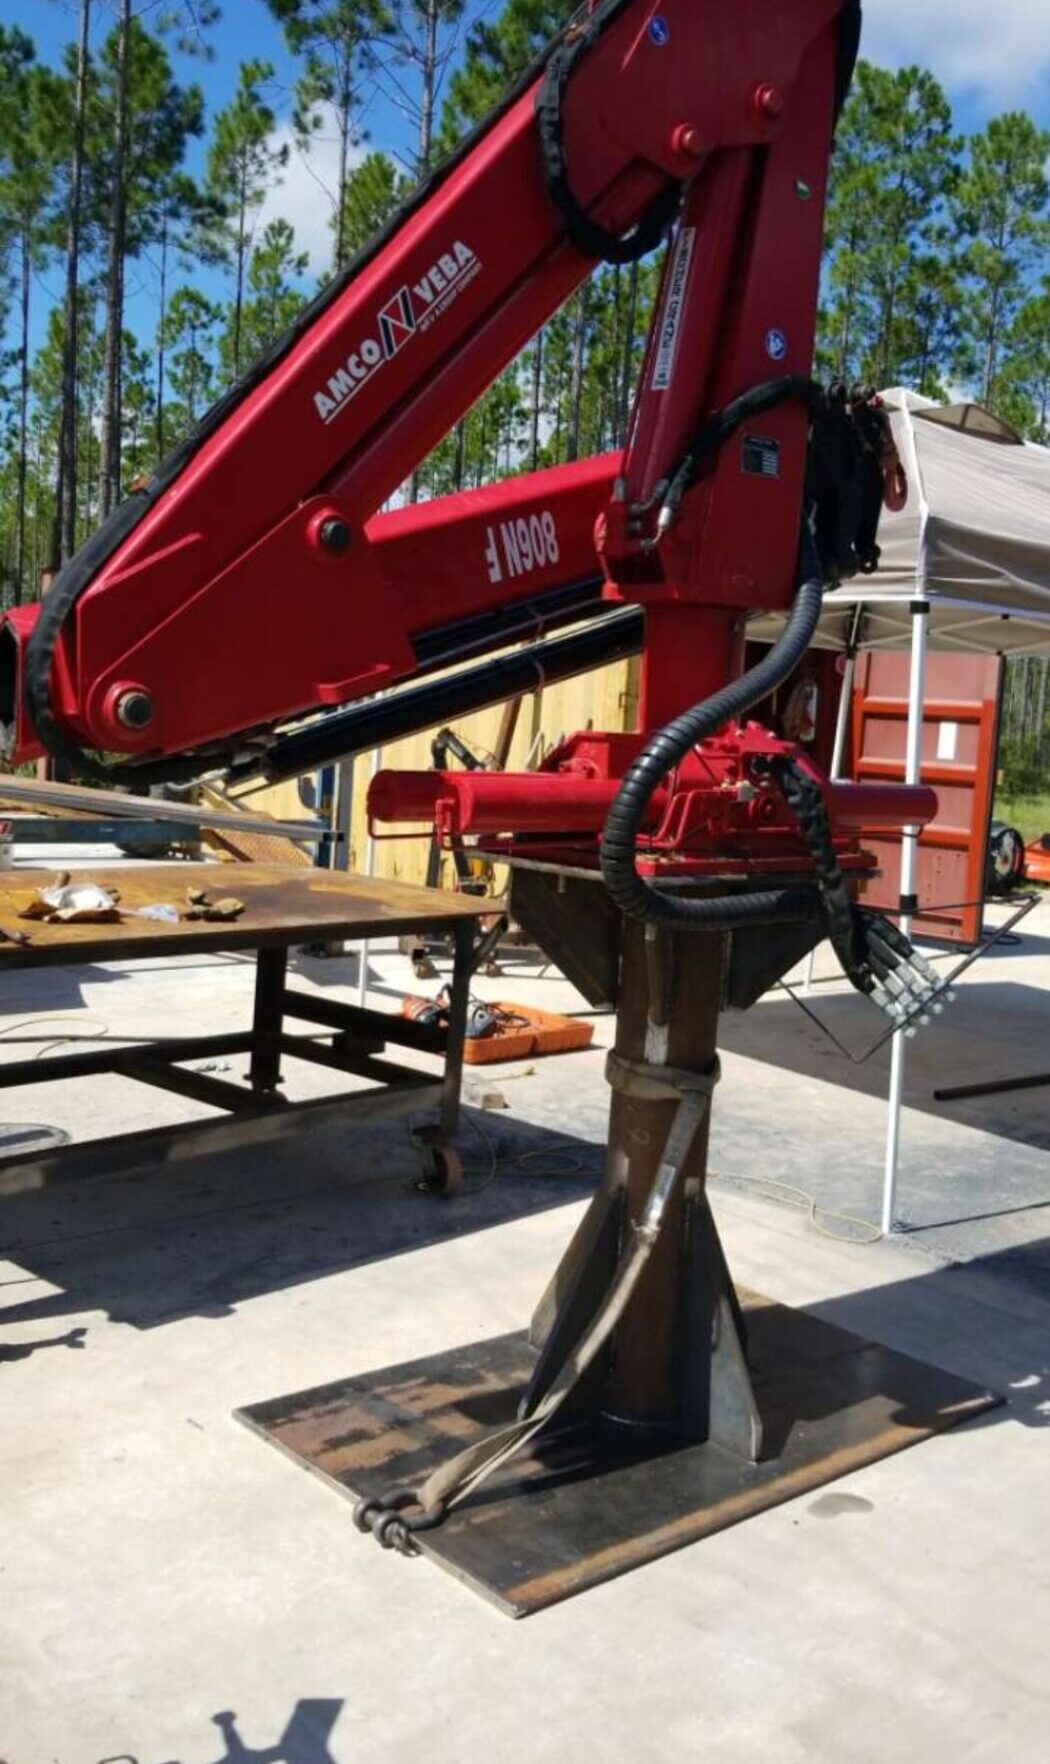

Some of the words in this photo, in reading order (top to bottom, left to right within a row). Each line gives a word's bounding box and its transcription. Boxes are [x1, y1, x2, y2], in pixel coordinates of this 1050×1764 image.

[313, 339, 380, 419] AMCO
[413, 241, 474, 303] VEBA
[500, 510, 559, 577] 806N
